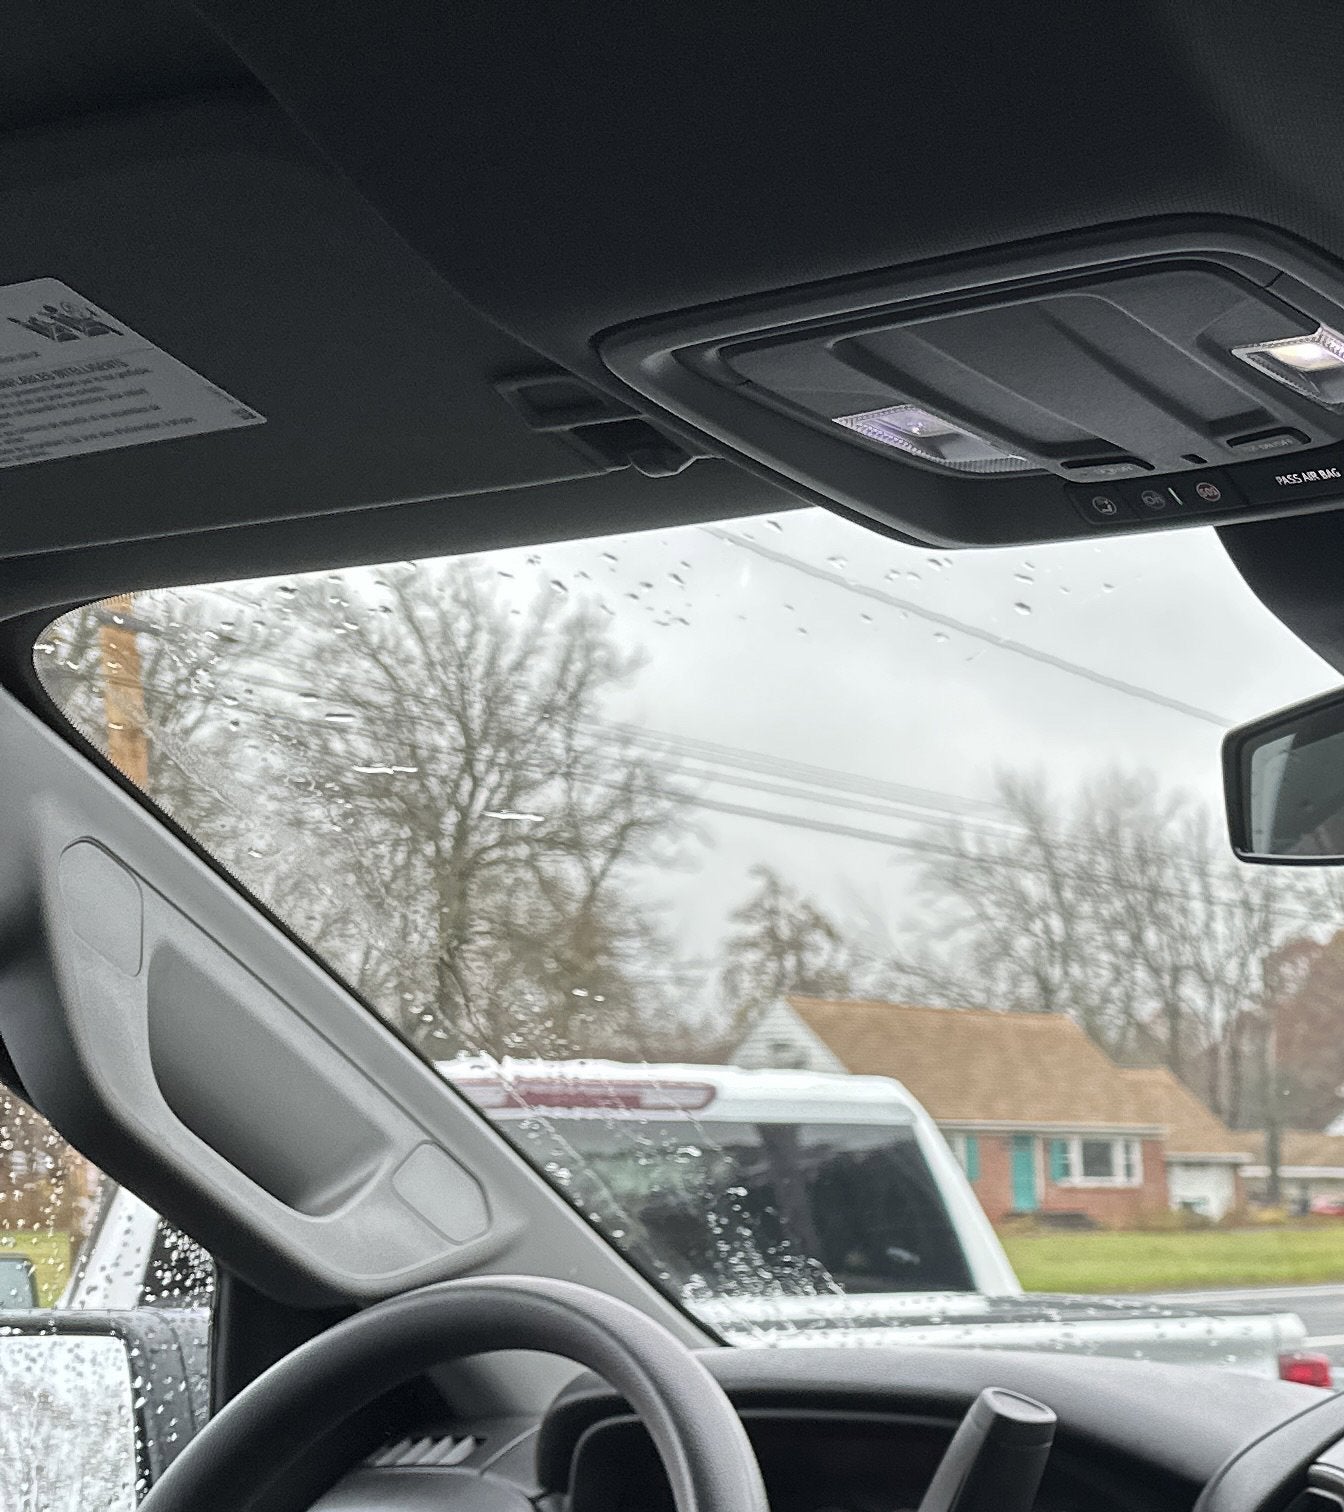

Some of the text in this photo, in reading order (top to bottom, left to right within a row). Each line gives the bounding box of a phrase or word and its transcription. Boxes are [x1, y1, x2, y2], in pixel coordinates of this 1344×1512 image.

[1275, 474, 1302, 486] PASS
[1302, 471, 1320, 482] AIR
[1319, 468, 1342, 480] BAG
